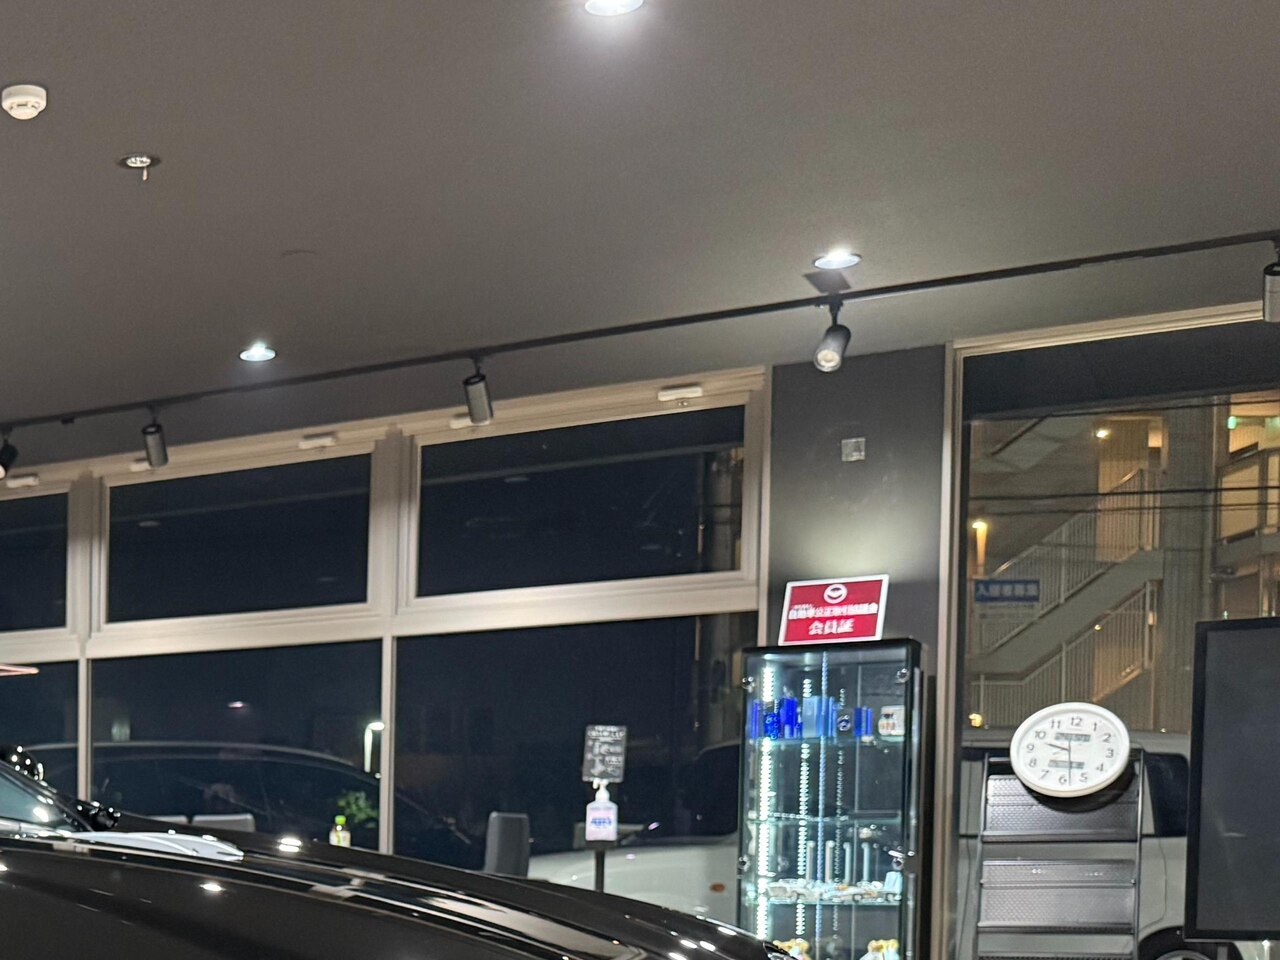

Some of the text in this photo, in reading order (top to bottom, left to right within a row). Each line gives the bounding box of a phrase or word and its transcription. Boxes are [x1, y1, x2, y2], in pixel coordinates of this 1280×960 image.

[1051, 720, 1061, 729] 11
[1070, 717, 1082, 727] 12
[1092, 722, 1098, 731] 1
[1034, 730, 1046, 740] 10
[1102, 733, 1112, 743] 2
[1026, 743, 1035, 753] 9
[1105, 748, 1114, 759] 3
[1029, 758, 1037, 768] 8
[1096, 763, 1104, 772] 4
[1040, 770, 1049, 779] 7
[1079, 772, 1089, 783] 5
[1059, 775, 1067, 785] 6
